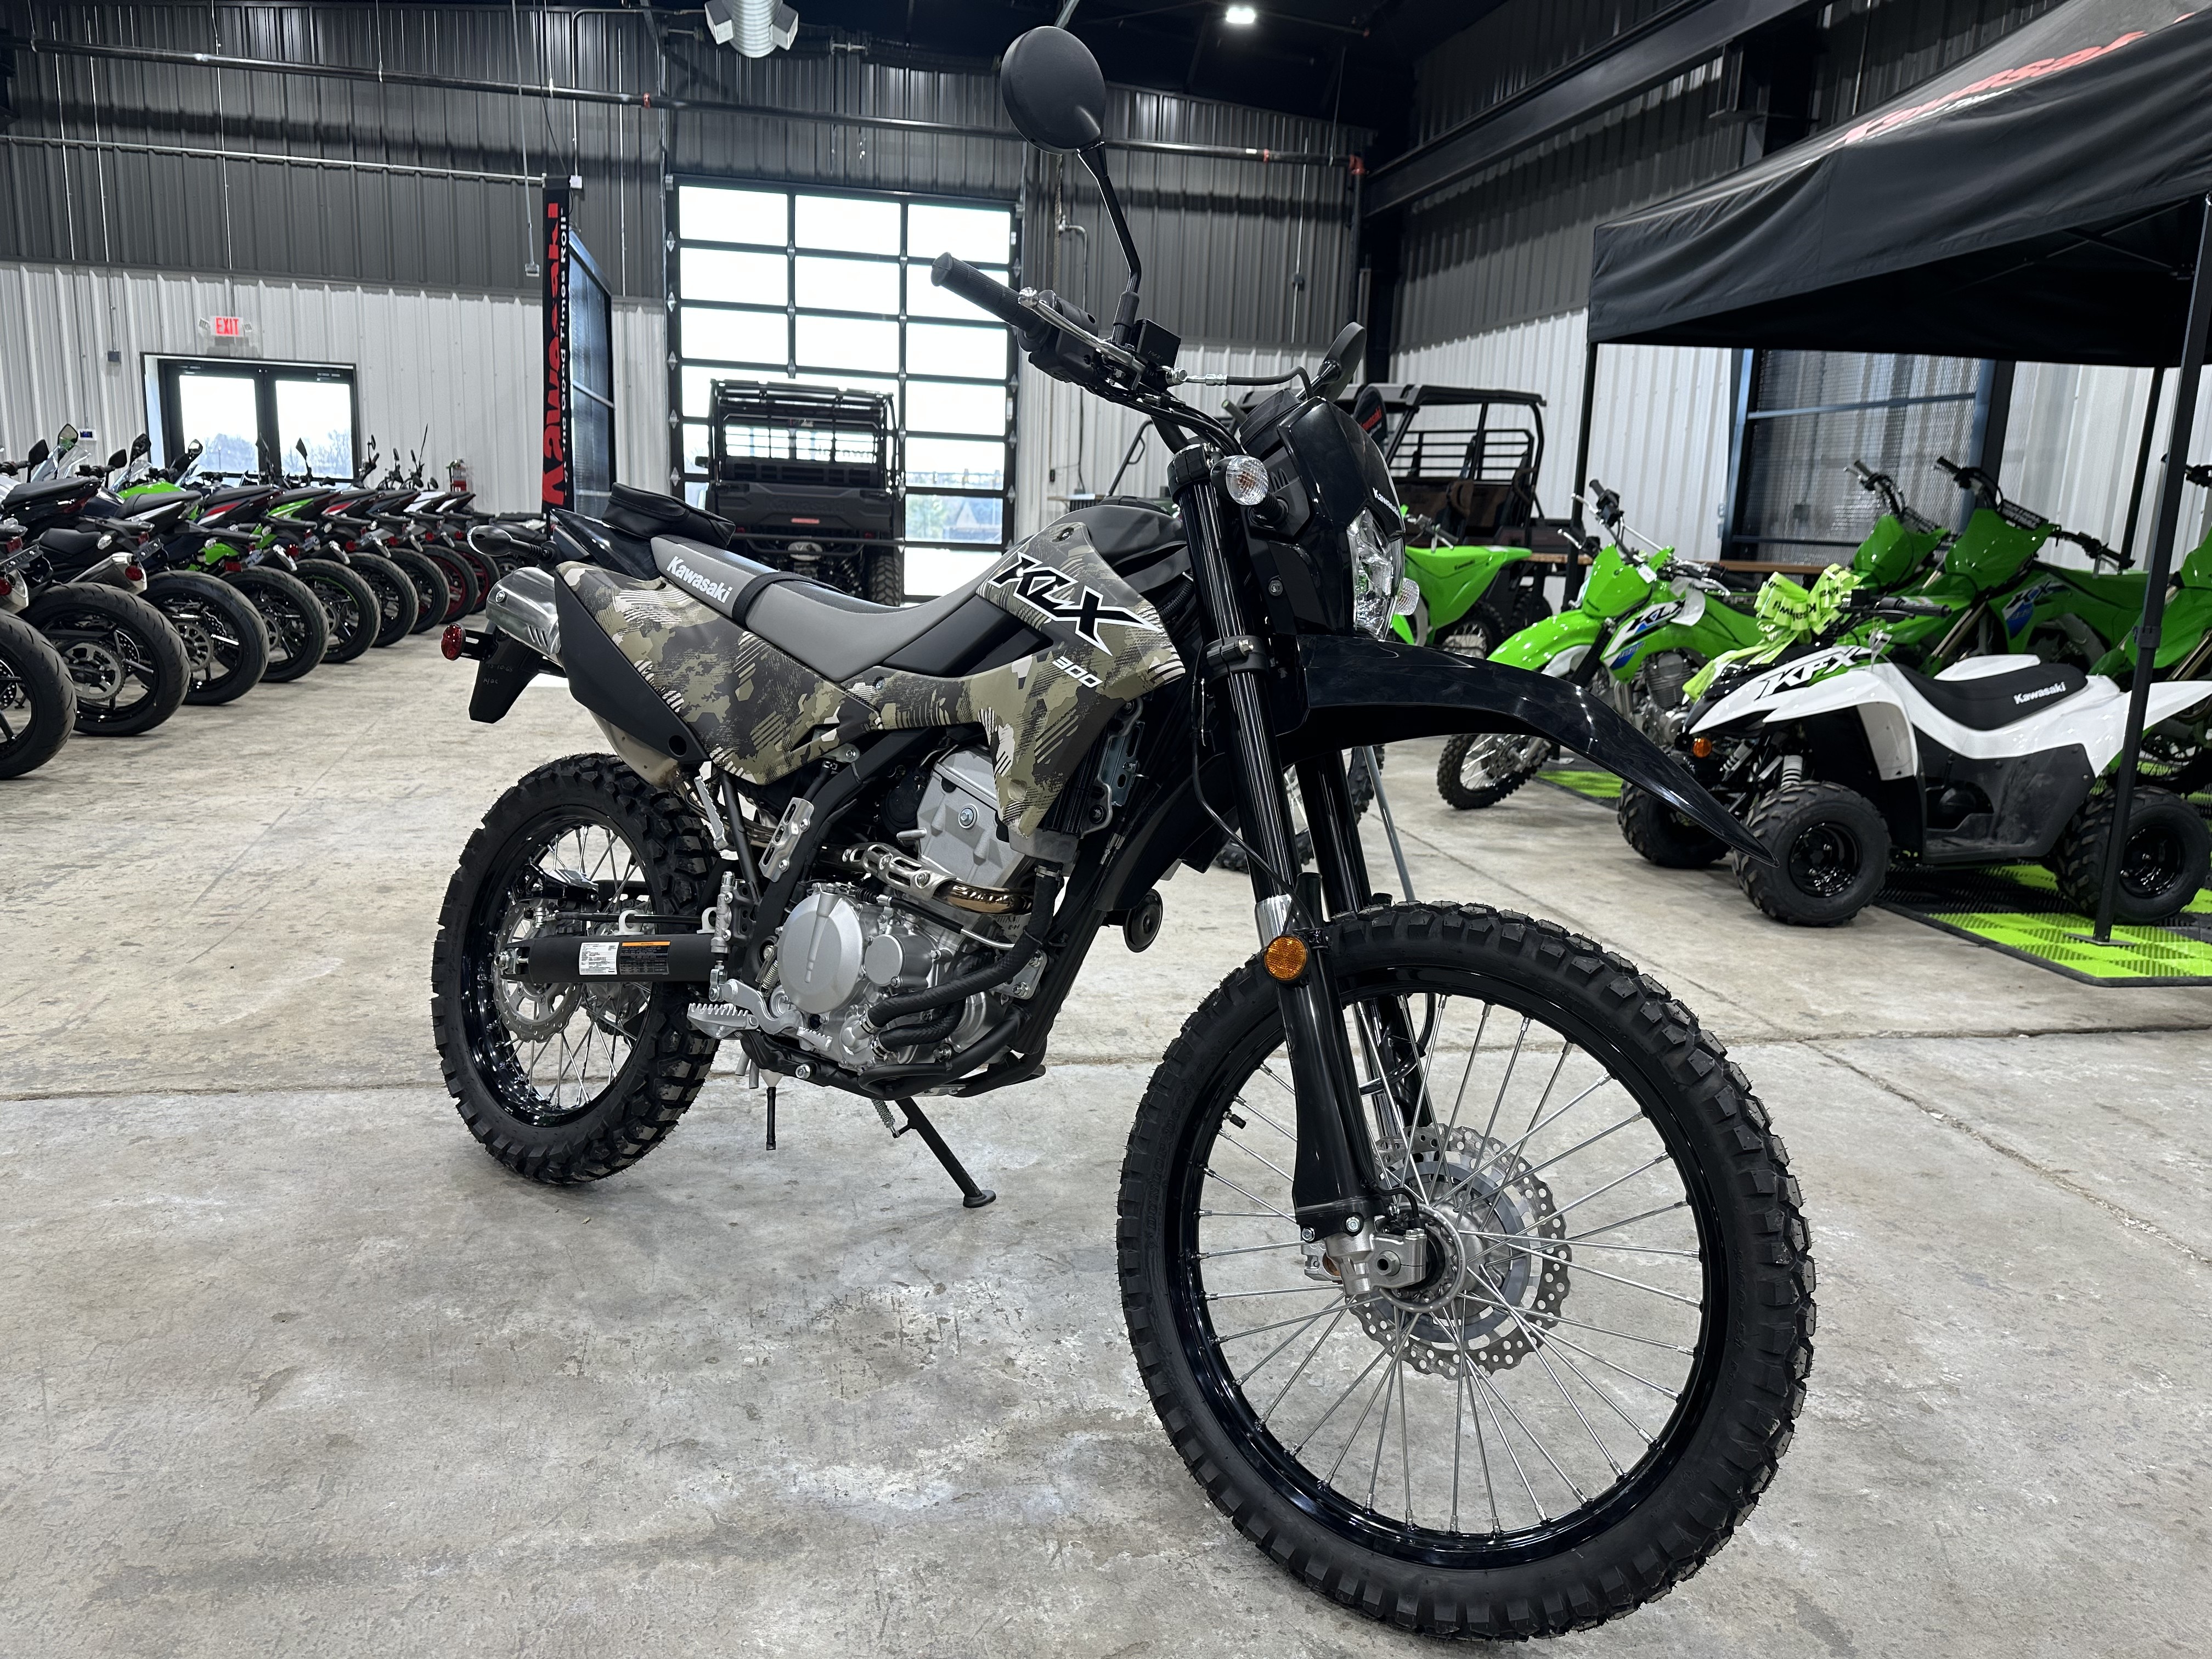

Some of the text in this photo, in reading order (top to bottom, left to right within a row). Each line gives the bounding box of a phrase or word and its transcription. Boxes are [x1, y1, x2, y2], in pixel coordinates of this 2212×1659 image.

[1826, 12, 2196, 149] Kawasak
[216, 317, 239, 336] EXIT
[666, 556, 733, 603] Kawasaki
[988, 551, 1164, 657] KLX
[1052, 656, 1103, 688] 300
[1754, 647, 1861, 701] KFX
[2013, 681, 2066, 705] Kawasaki
